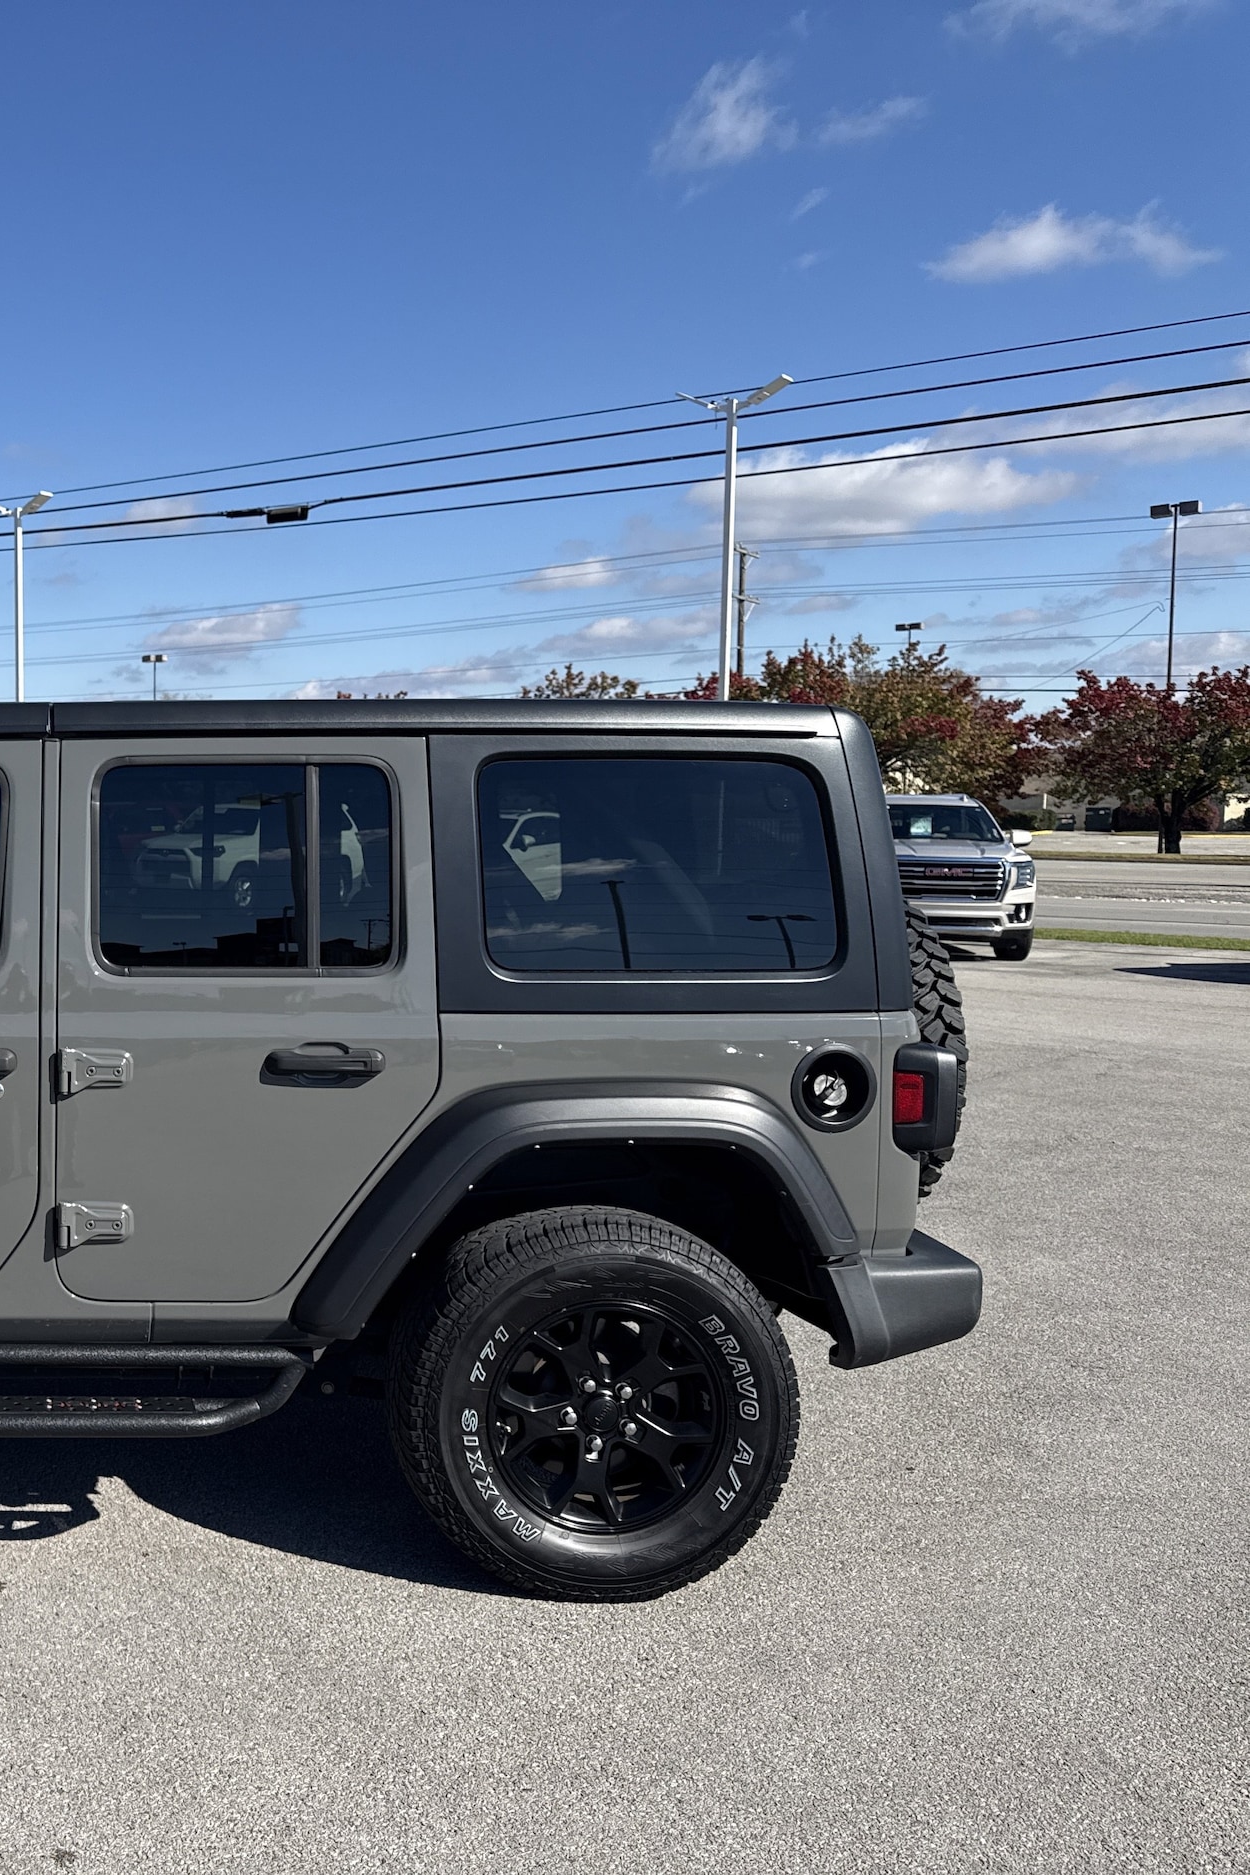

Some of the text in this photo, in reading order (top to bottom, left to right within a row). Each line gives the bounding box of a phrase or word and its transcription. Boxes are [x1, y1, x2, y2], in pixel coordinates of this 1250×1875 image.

[925, 867, 974, 877] GMC
[469, 1325, 509, 1383] 771
[698, 1314, 760, 1511] BRAVO A/T
[461, 1407, 541, 1542] MAXXIS
